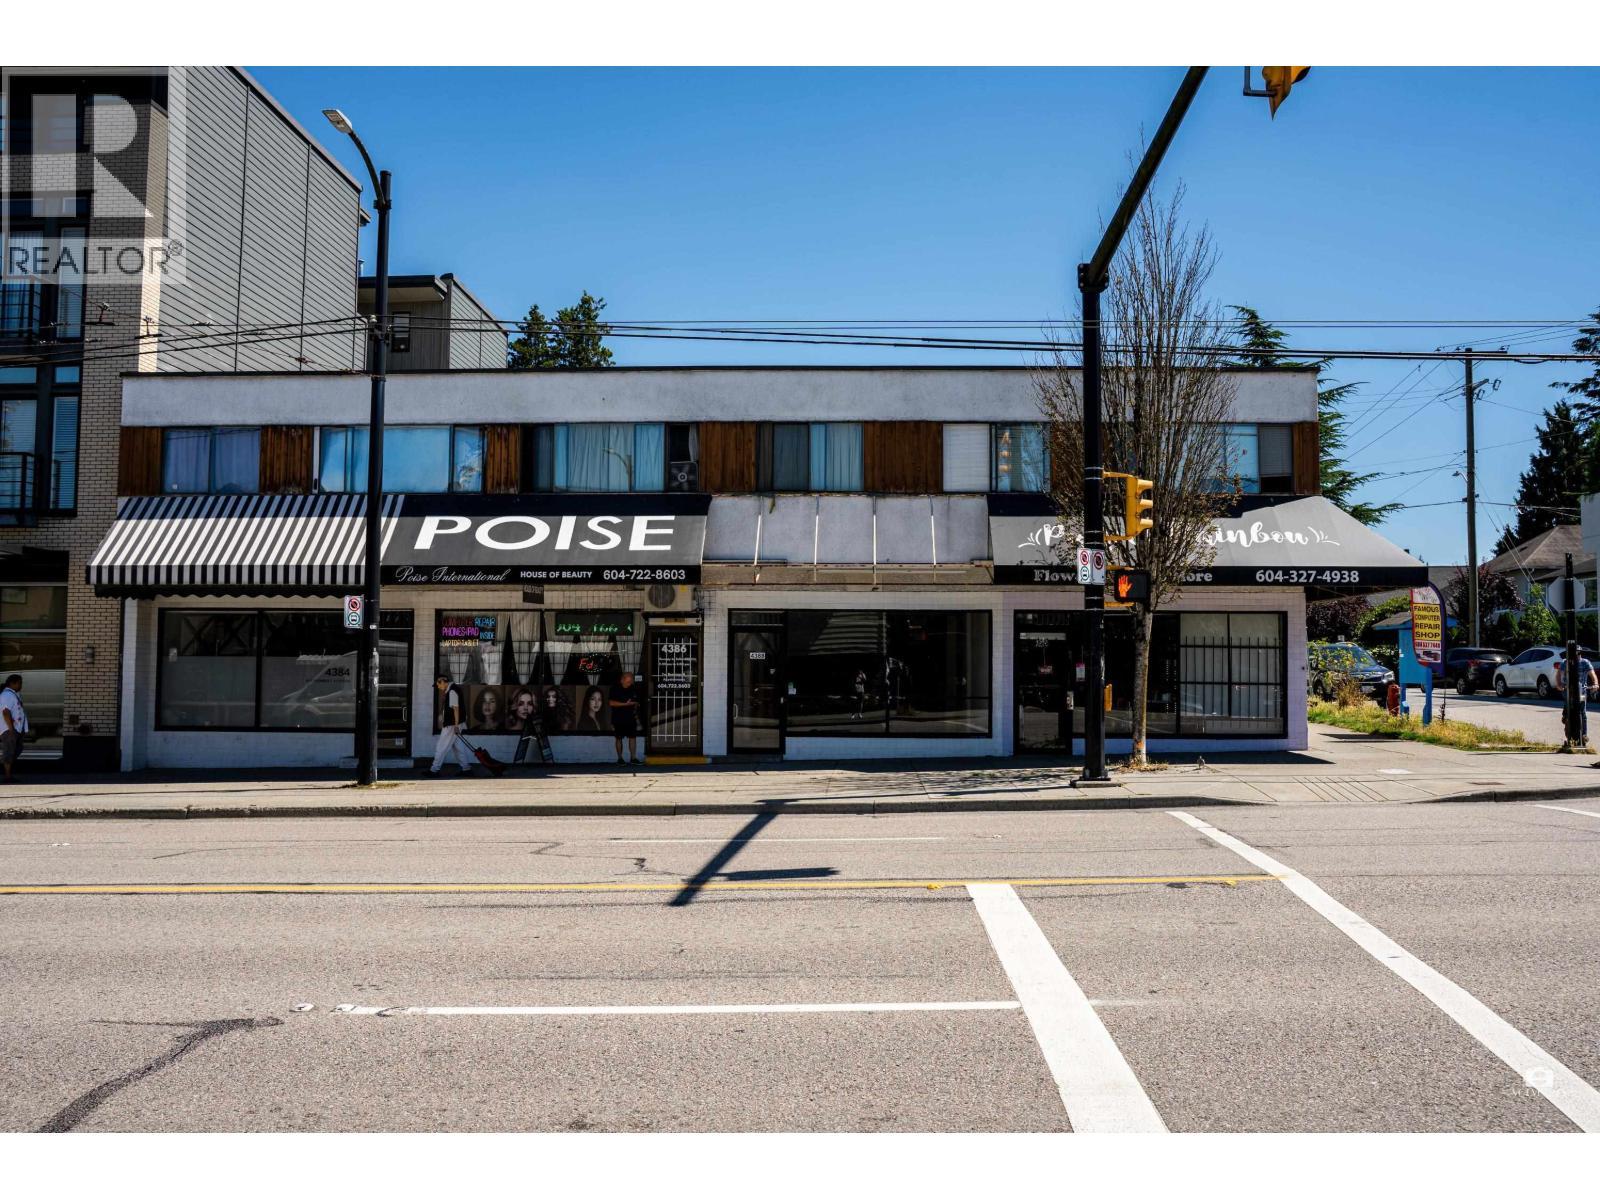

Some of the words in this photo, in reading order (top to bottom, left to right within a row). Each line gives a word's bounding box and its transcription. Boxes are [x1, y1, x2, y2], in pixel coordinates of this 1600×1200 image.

[413, 515, 676, 551] POISE
[394, 565, 429, 583] Poise
[431, 565, 512, 583] International
[520, 570, 548, 579] HOUSE
[548, 571, 561, 579] OF
[561, 571, 593, 579] BEAUTY
[603, 569, 686, 581] 604-722-8603
[1255, 569, 1360, 583] 604-327-4938
[1413, 605, 1440, 613] FAMOUS
[474, 616, 496, 627] REPAIR
[1415, 614, 1441, 622] COMPUTER
[1415, 622, 1441, 631] REPAIR
[1415, 631, 1441, 639] SHOP
[661, 644, 688, 654] 4386
[325, 667, 350, 677] 4384
